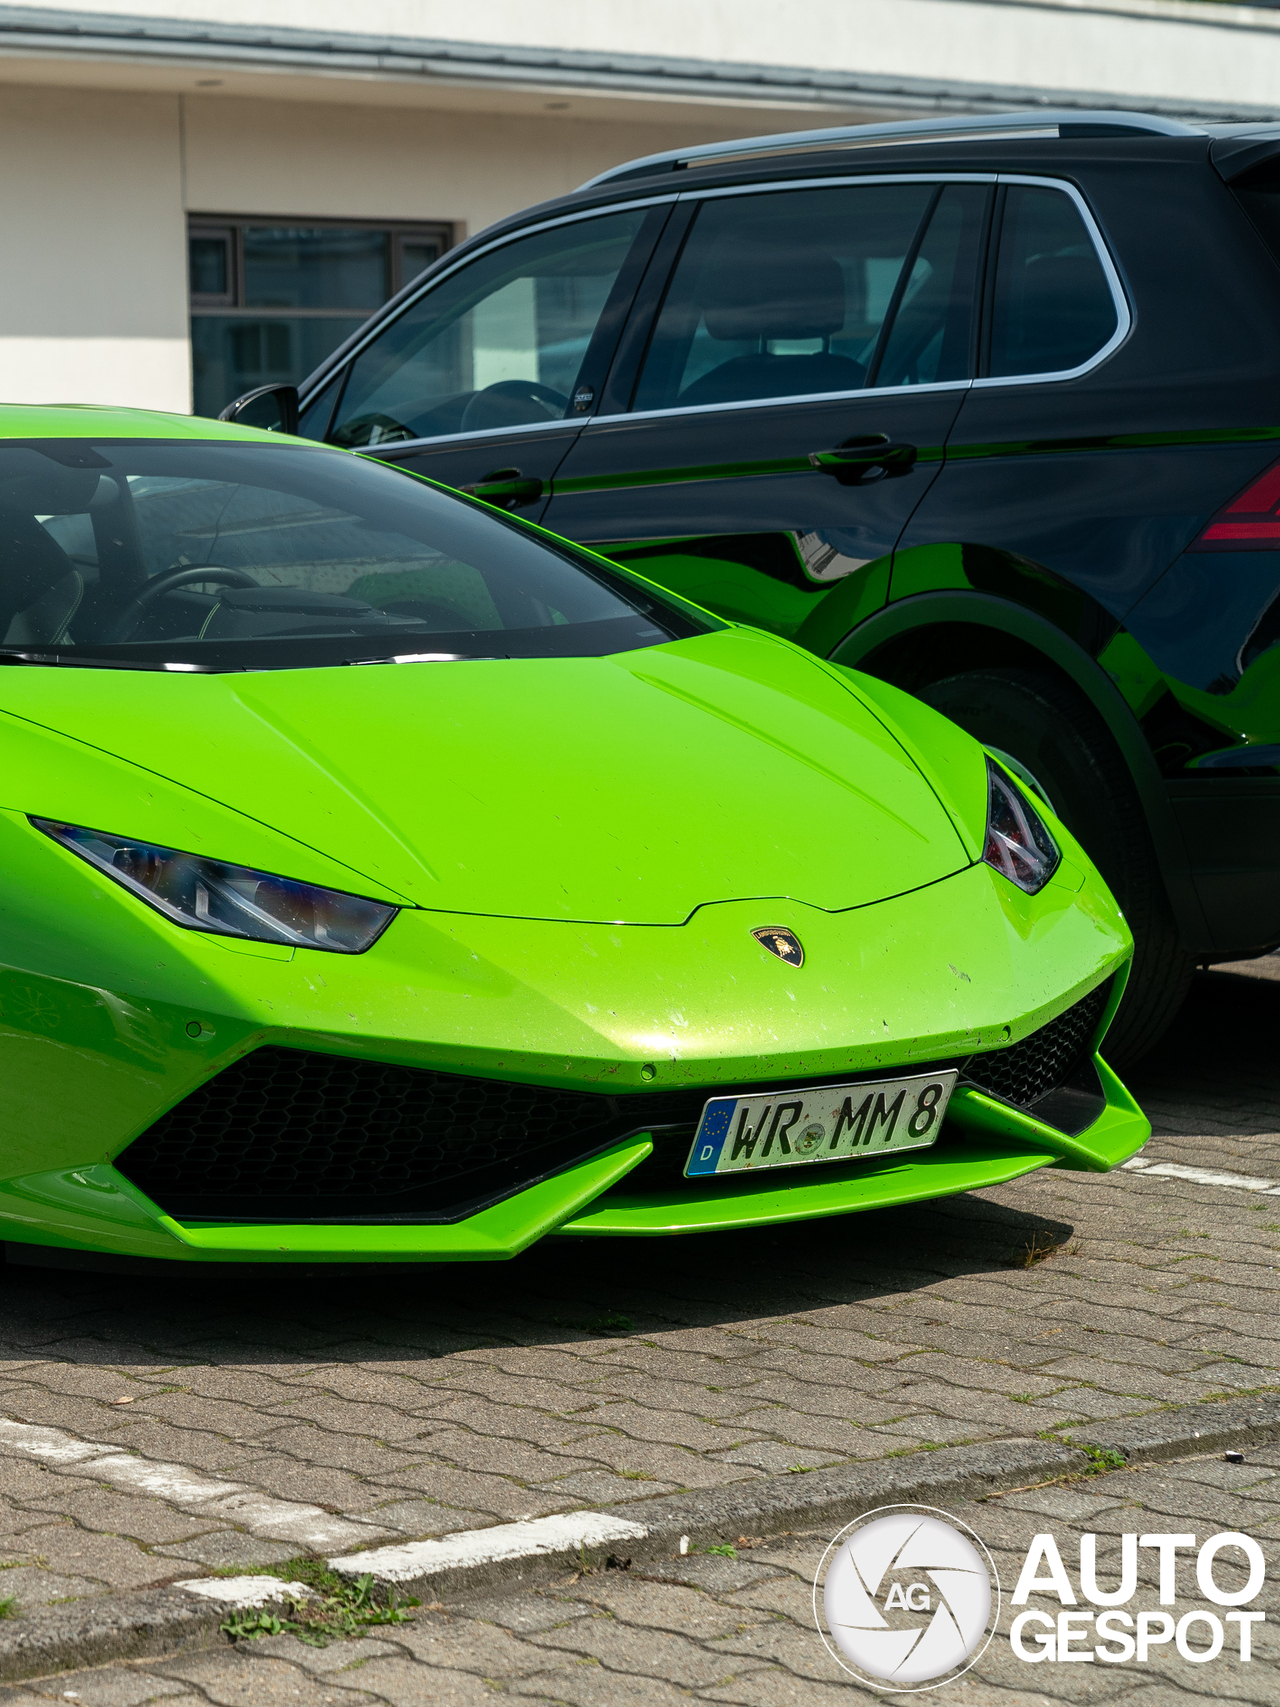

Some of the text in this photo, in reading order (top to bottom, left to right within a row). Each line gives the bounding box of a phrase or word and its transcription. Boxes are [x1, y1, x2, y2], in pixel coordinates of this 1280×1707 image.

[730, 1100, 804, 1161] WR
[829, 1087, 907, 1150] MM
[907, 1082, 945, 1138] 8
[700, 1145, 714, 1161] D
